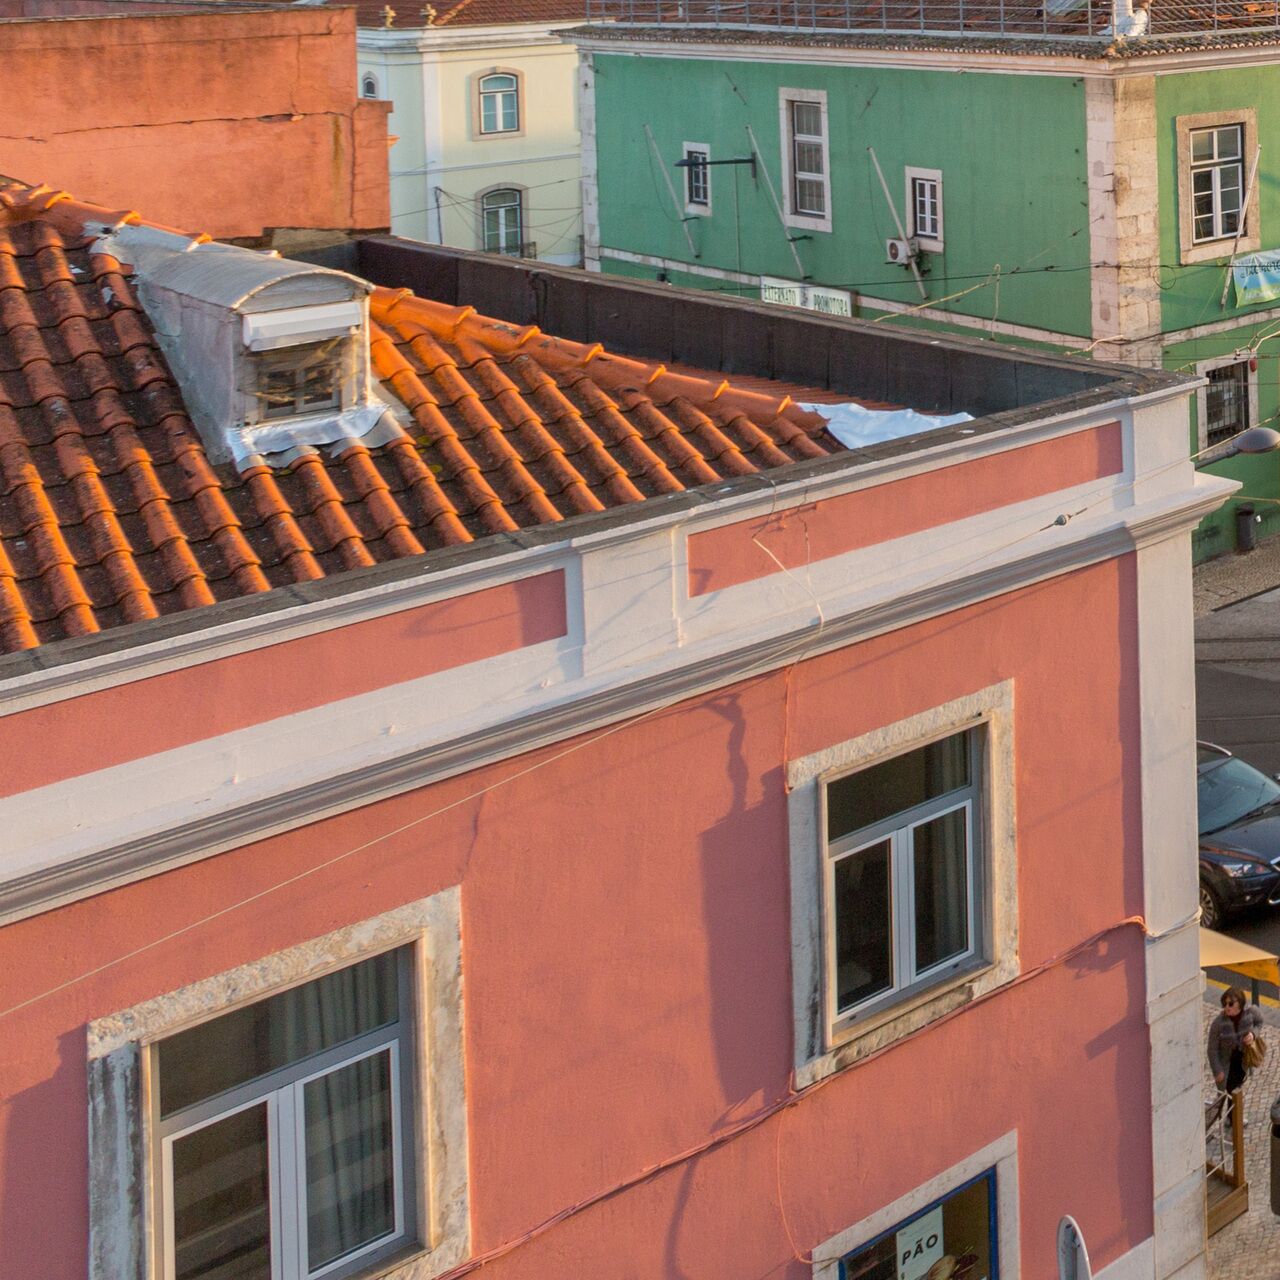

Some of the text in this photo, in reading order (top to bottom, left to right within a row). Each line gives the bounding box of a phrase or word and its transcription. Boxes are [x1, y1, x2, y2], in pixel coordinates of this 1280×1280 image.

[763, 284, 797, 306] EXTERNATO
[813, 294, 848, 316] PROMOTORA
[902, 1233, 939, 1266] PÃO
